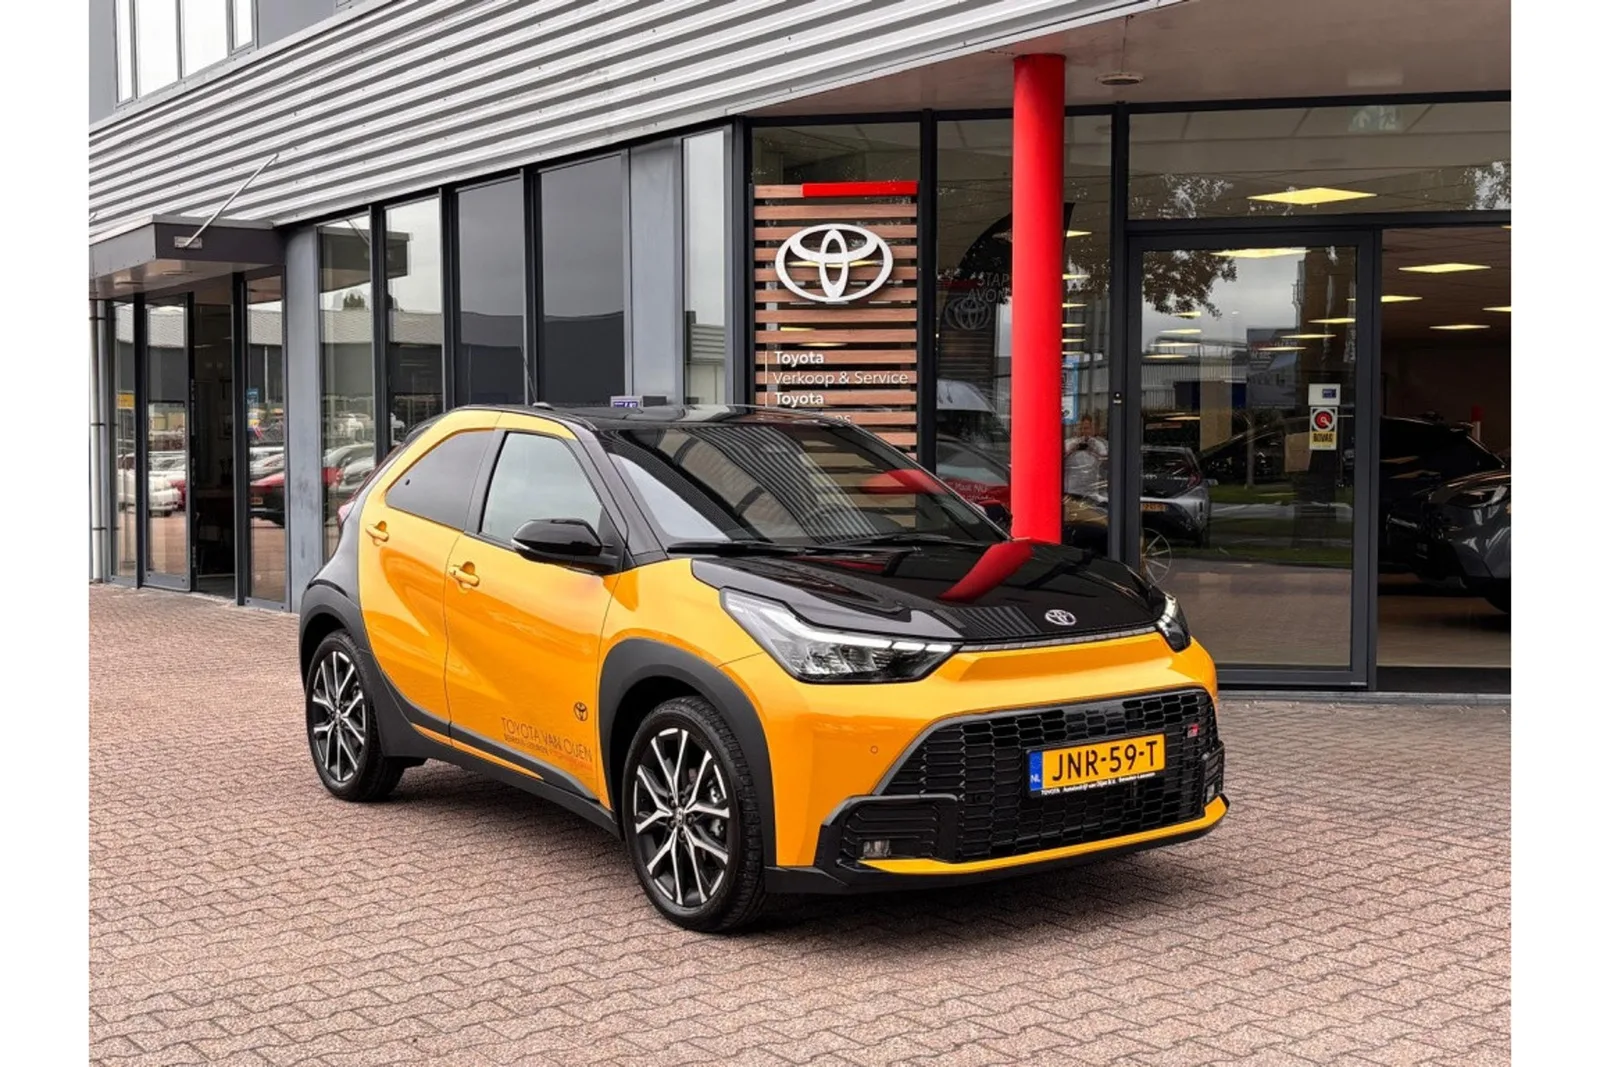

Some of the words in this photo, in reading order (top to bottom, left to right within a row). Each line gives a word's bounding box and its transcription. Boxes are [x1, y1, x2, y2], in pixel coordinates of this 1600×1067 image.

[967, 288, 1012, 303] AVON
[774, 351, 825, 367] Toyota
[772, 371, 835, 387] Verkoop
[838, 372, 851, 384] &
[854, 370, 909, 384] Service
[774, 391, 825, 407] Toyota
[501, 716, 540, 743] TOYOTA
[1051, 740, 1158, 781] JNR-59-T
[1030, 774, 1041, 784] NL
